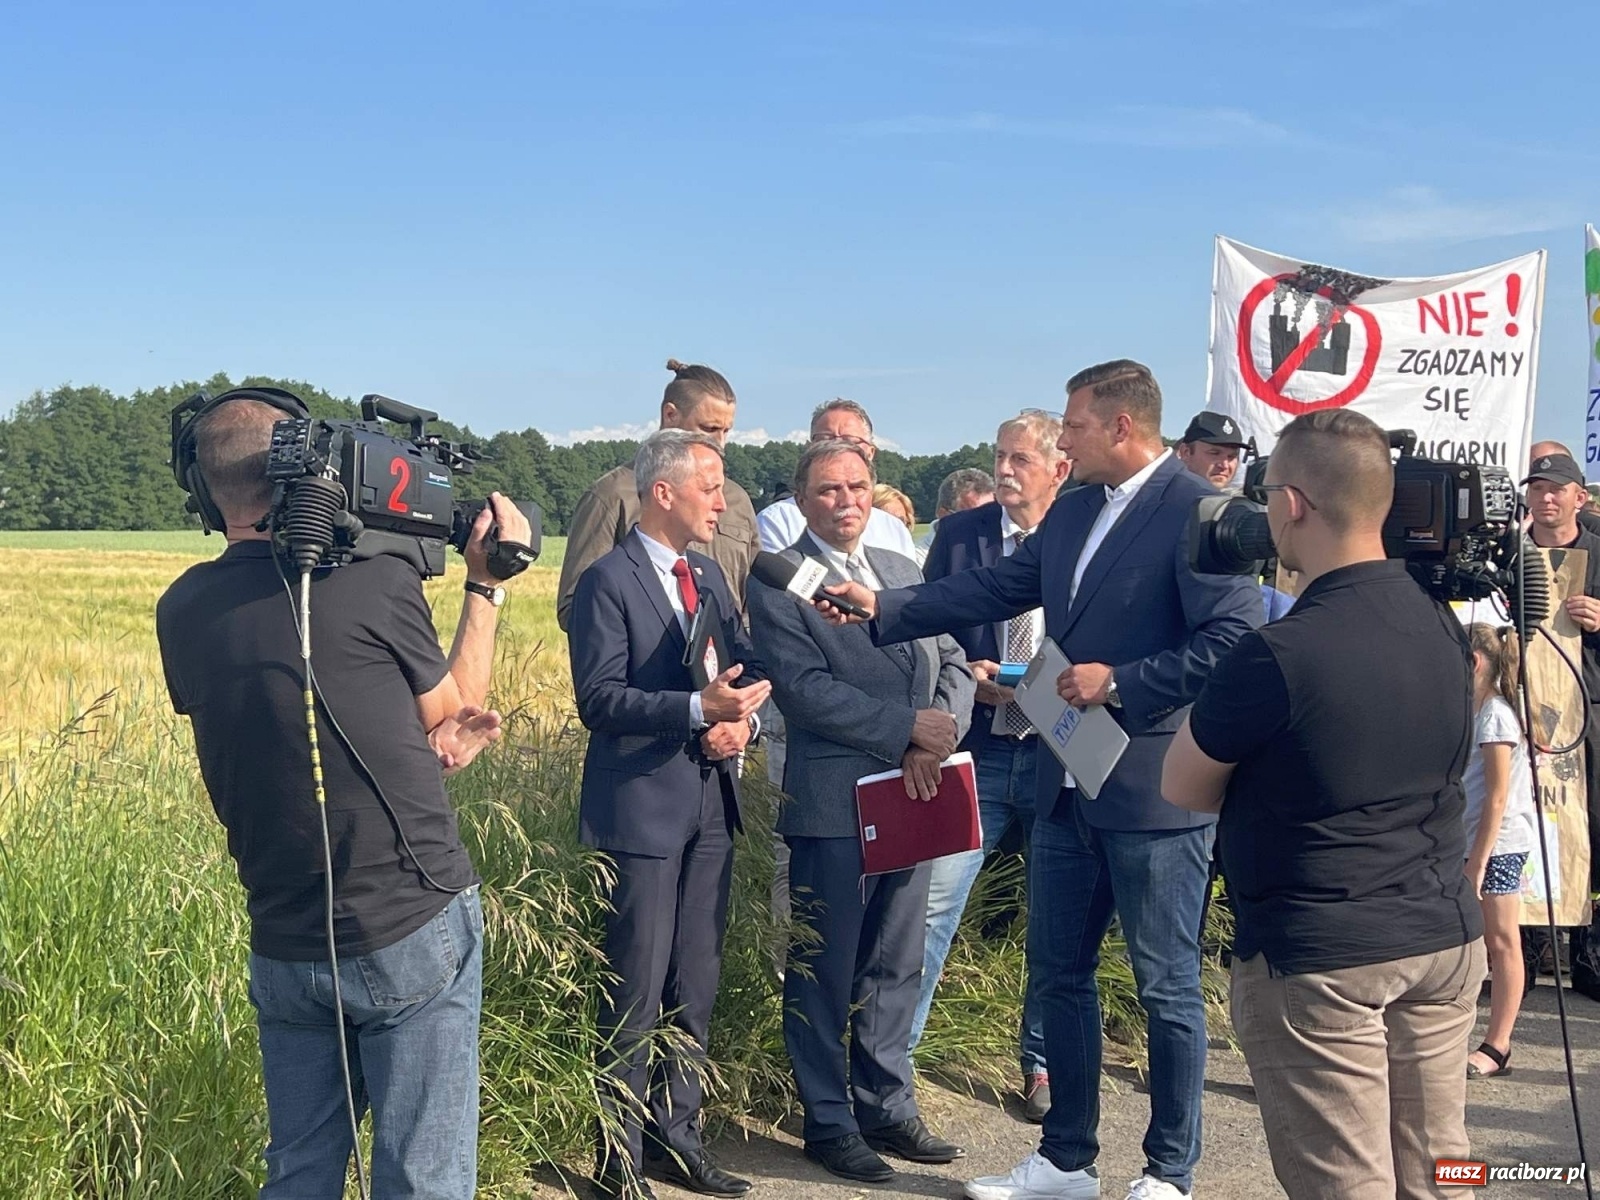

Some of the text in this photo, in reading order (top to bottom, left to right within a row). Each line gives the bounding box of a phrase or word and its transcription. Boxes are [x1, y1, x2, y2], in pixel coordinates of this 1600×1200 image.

[1417, 291, 1489, 337] NIE
[1397, 348, 1524, 378] ZGADZAMY
[1422, 386, 1471, 421] SIĘ
[1414, 438, 1507, 466] ALCIARNI
[388, 456, 411, 513] 2
[1054, 709, 1076, 742] TVP
